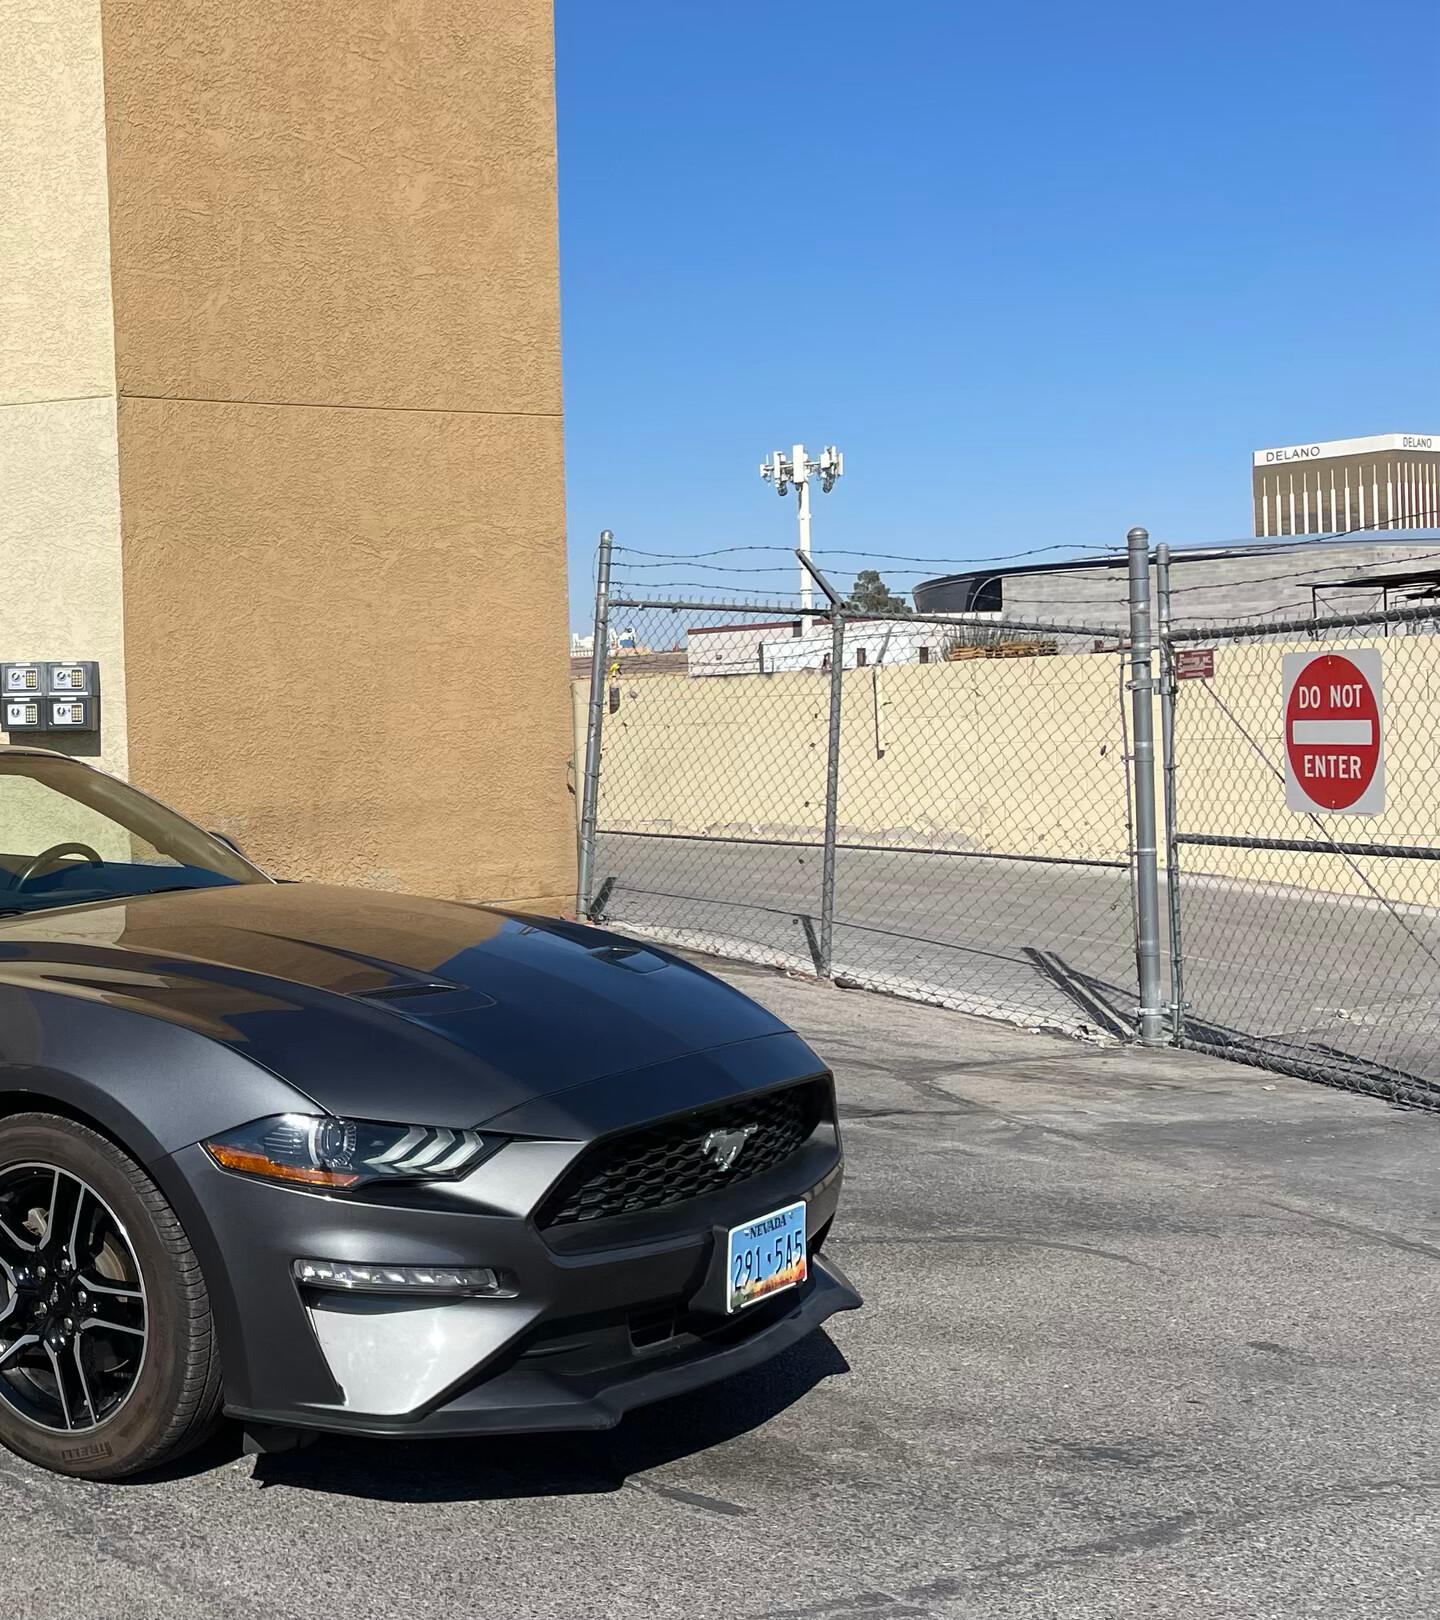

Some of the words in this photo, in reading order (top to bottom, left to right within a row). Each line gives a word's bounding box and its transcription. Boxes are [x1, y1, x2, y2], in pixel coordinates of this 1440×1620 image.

[1266, 446, 1320, 462] DELANO
[1403, 437, 1432, 449] DELANO
[1298, 685, 1320, 709] DO
[1329, 684, 1363, 708] NOT
[1303, 755, 1362, 779] ENTER
[750, 1214, 787, 1239] NEVADA
